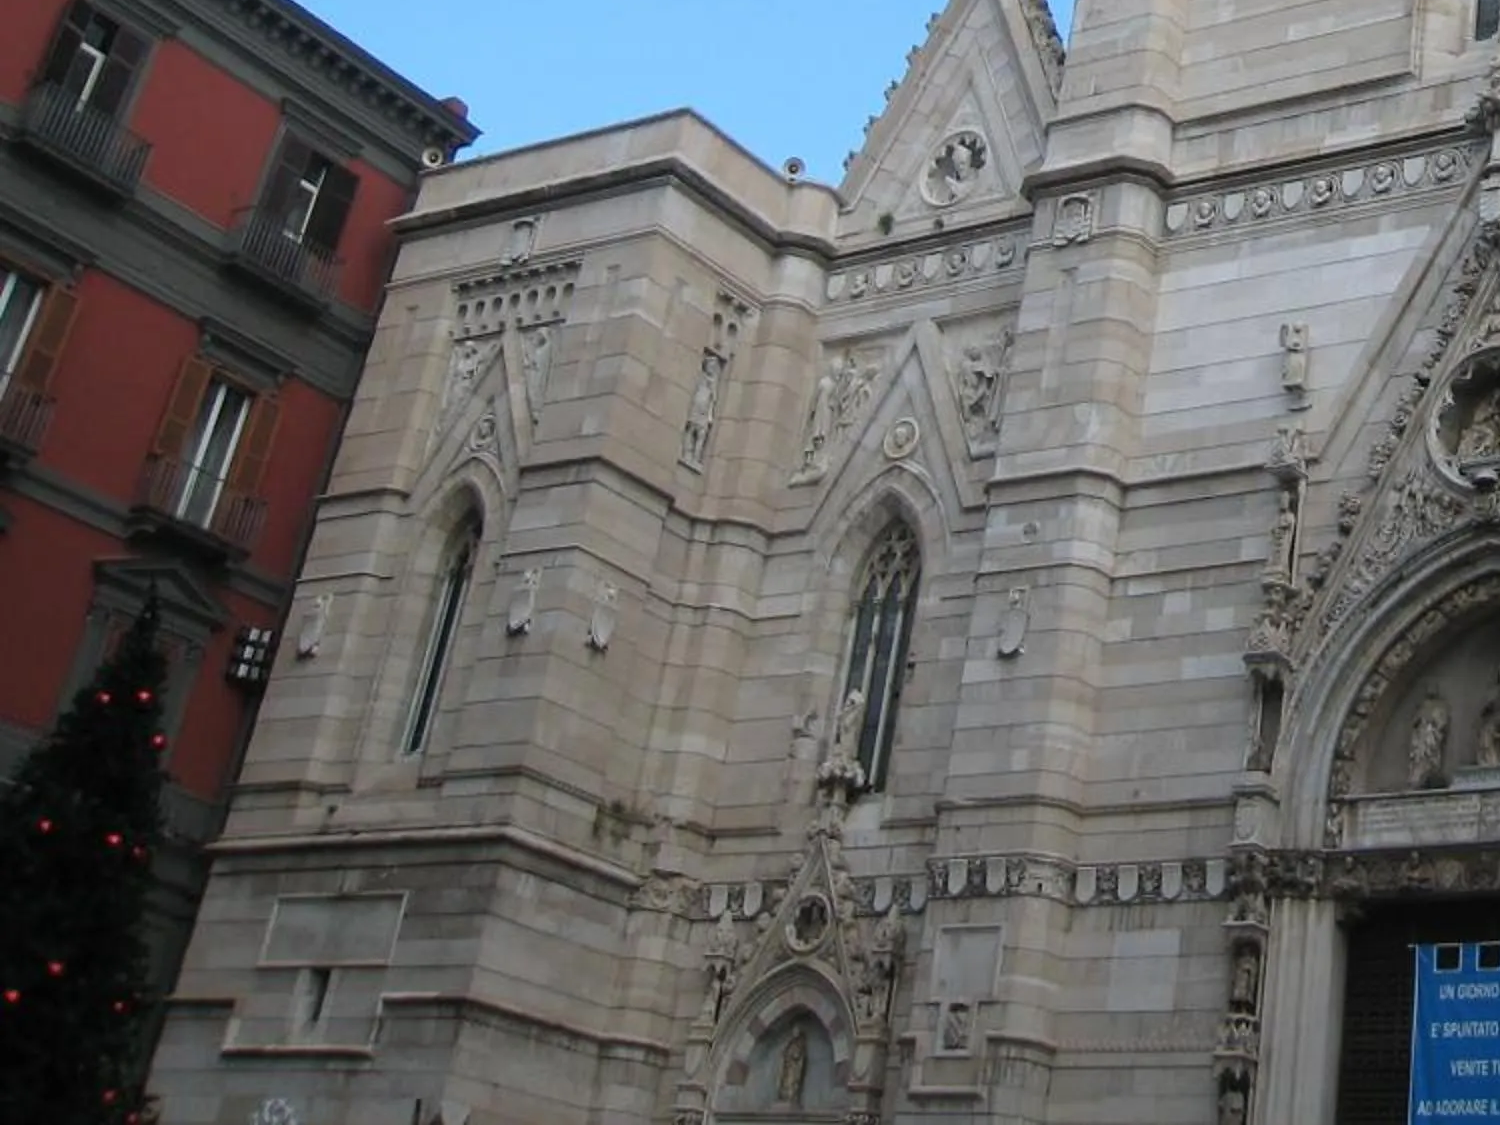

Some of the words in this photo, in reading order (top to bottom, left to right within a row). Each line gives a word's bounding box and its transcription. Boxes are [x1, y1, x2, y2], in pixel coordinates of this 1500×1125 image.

[1439, 984, 1455, 1000] UN
[1458, 983, 1499, 1000] GIORNO
[1443, 1021, 1499, 1038] SPUNTATO
[1450, 1059, 1489, 1076] VENITE
[1417, 1099, 1434, 1116] AD
[1435, 1099, 1488, 1116] ADORARE
[1490, 1099, 1500, 1116] IL
